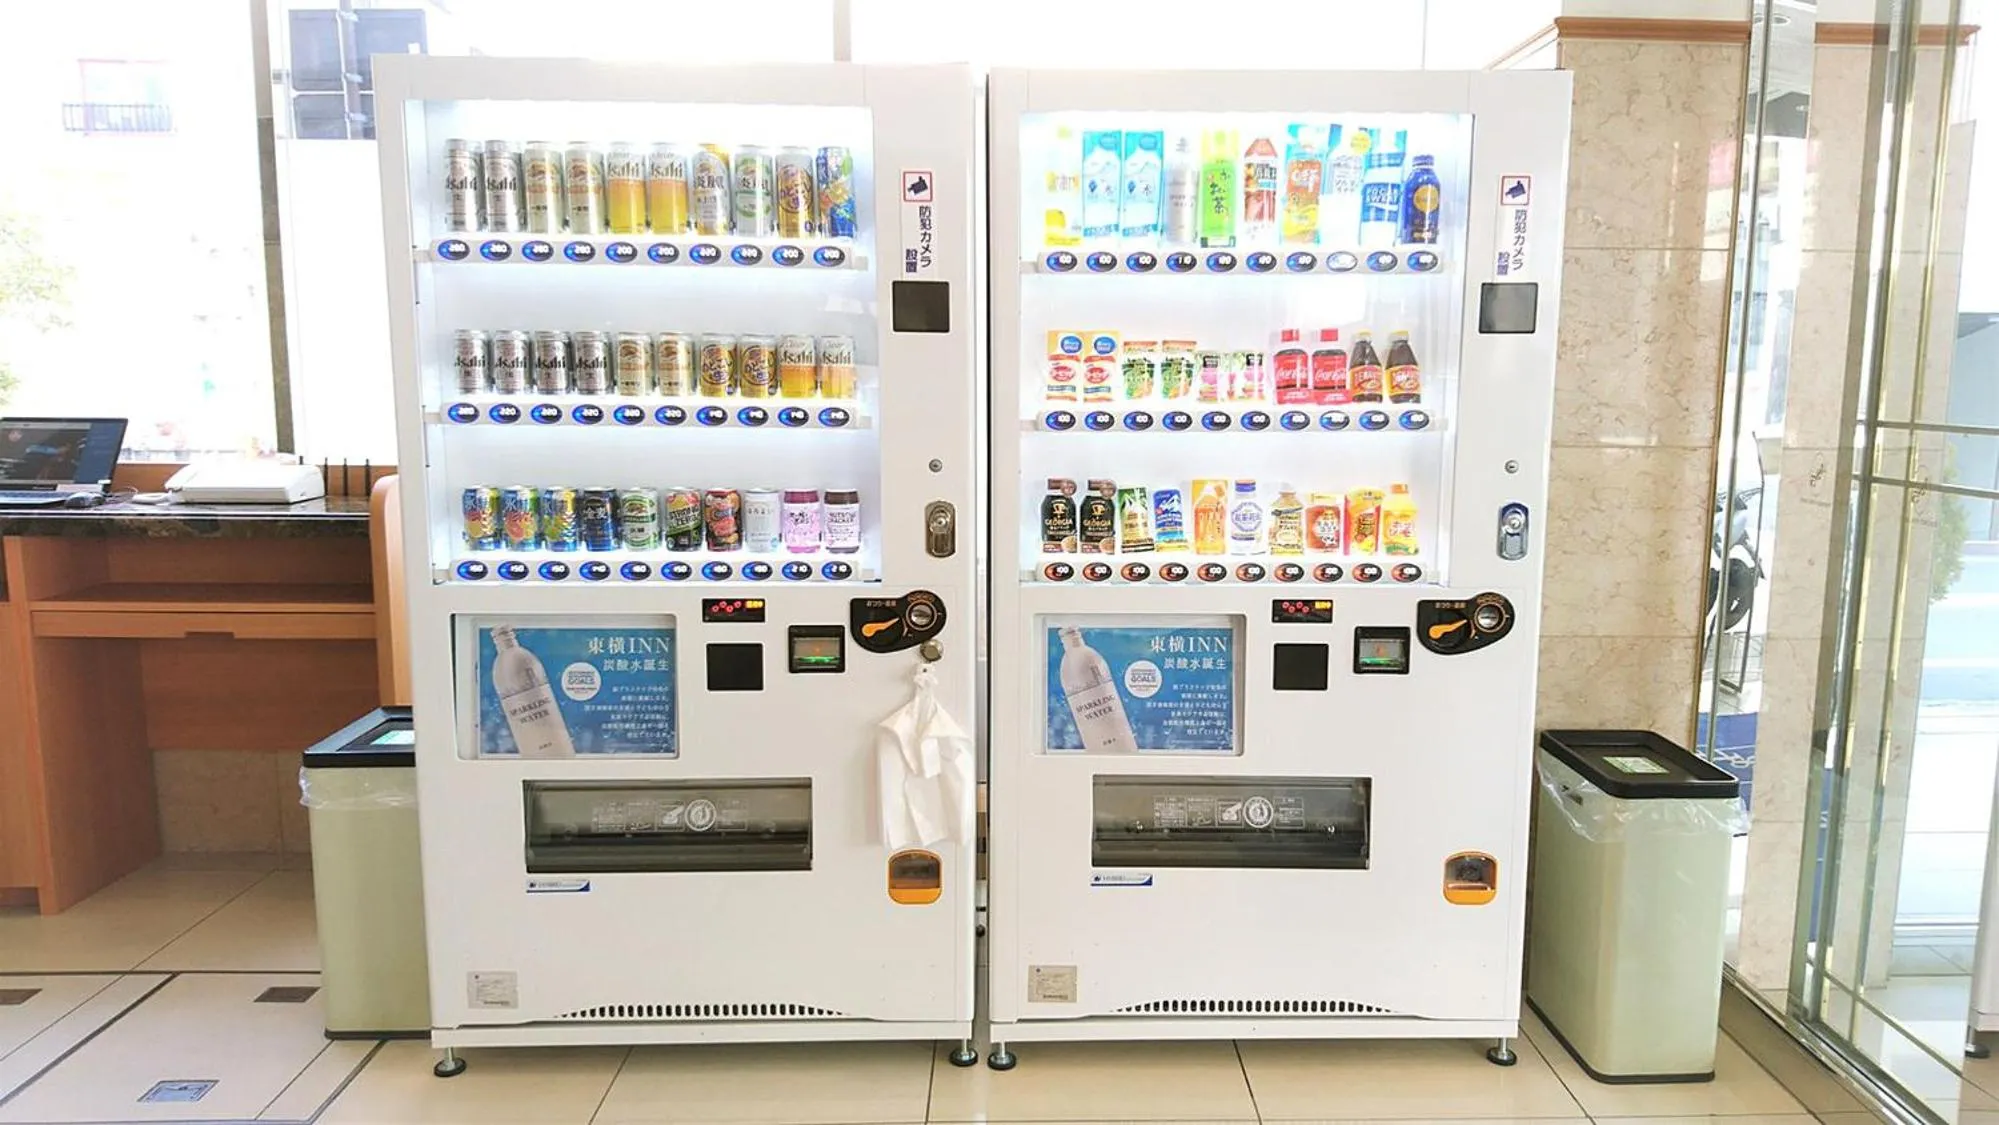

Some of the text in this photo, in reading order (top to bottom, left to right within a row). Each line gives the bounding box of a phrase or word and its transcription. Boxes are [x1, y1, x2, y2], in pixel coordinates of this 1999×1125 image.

[918, 205, 933, 268] 防犯カメラ
[1512, 209, 1528, 271] 防犯カメラ
[905, 248, 918, 273] 設置
[1044, 518, 1073, 527] GEORGIA
[1083, 518, 1111, 527] GEORGIA
[587, 637, 671, 655] 東横INN
[1150, 636, 1227, 654] 東横INN
[603, 659, 670, 674] 炭酸水誕生
[1163, 657, 1227, 671] 炭酸水誕生
[509, 696, 551, 717] SPARKLING
[1075, 696, 1116, 714] SPARKLING
[1084, 706, 1115, 721] WATER
[519, 710, 551, 725] WATER
